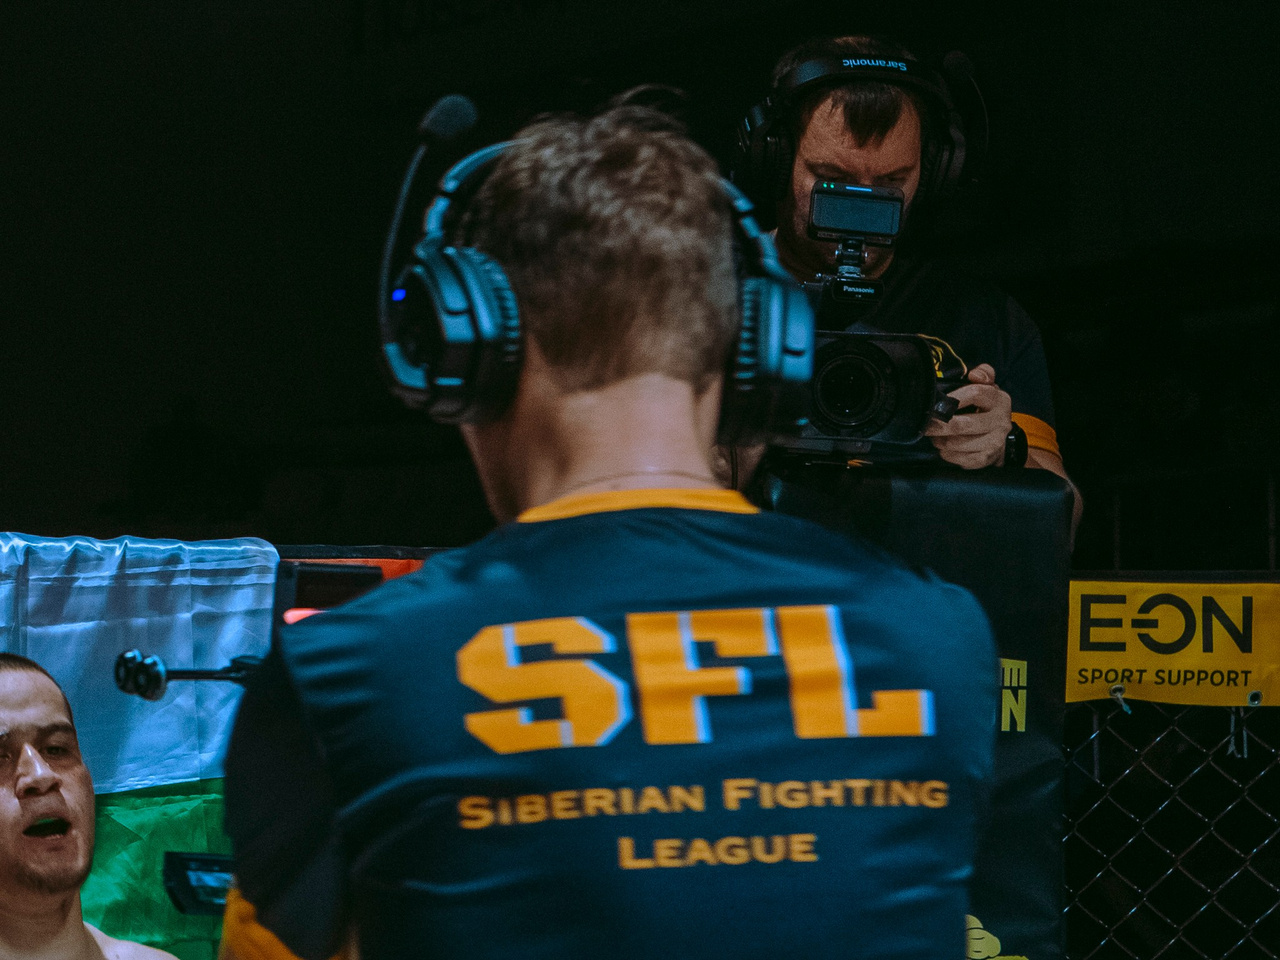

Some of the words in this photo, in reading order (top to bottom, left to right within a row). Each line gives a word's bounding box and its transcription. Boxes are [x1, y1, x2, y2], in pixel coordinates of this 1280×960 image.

[842, 58, 908, 72] Saramonic
[843, 285, 875, 294] Panasonic
[456, 604, 936, 754] SFL
[1077, 668, 1148, 685] SPORT
[1154, 669, 1253, 687] SUPPORT
